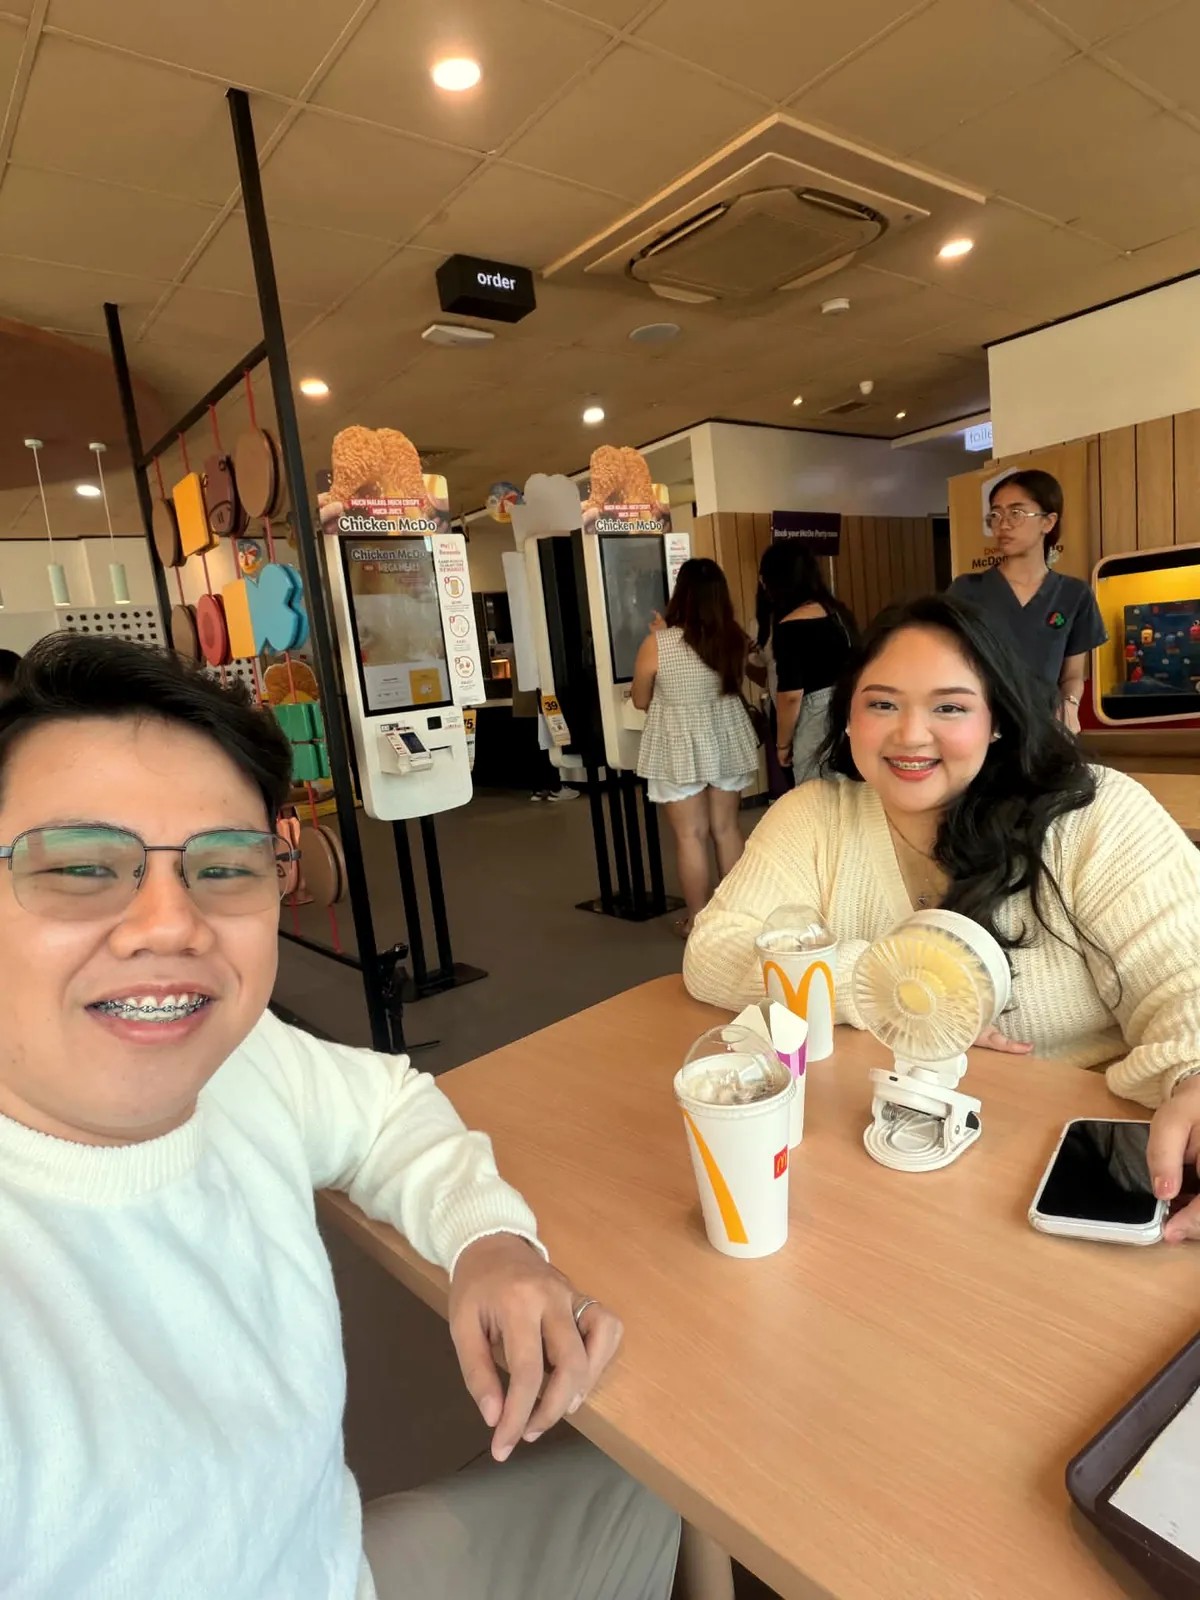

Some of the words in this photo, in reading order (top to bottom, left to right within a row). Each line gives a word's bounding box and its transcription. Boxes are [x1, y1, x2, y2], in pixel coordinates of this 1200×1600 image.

[477, 272, 516, 290] order
[339, 516, 396, 531] Chicken
[399, 517, 436, 531] McDo
[596, 519, 635, 531] Chicken
[636, 520, 662, 531] McDo
[352, 549, 396, 560] Chicken
[397, 549, 426, 559] McDo
